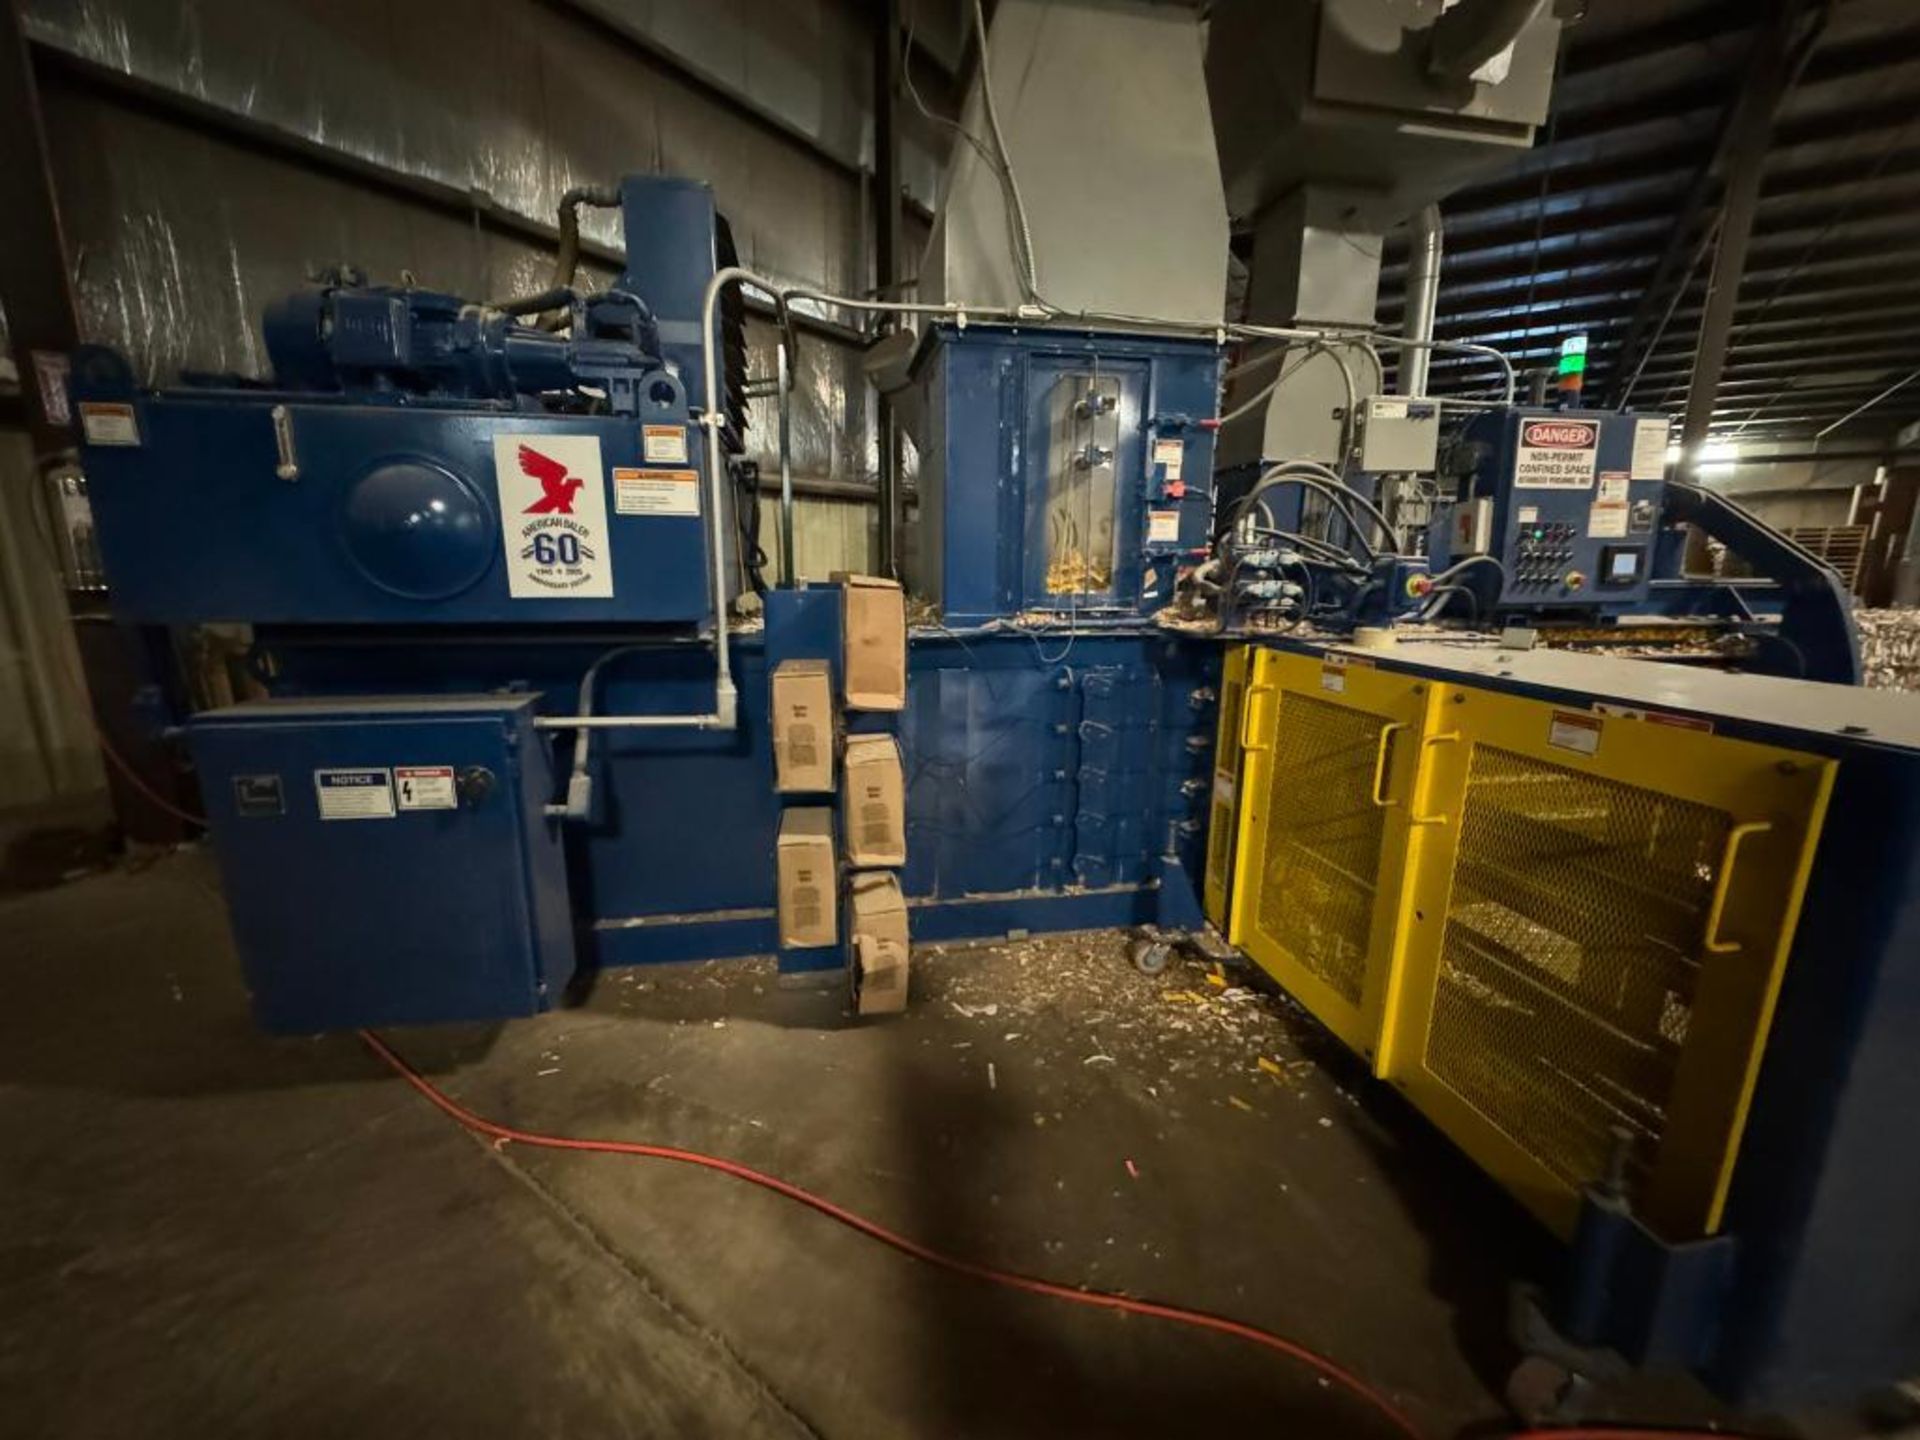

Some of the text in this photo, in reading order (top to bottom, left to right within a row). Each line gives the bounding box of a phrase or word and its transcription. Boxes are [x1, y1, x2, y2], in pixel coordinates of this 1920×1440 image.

[1531, 427, 1587, 443] DANGER
[1530, 452, 1583, 463] NON-PERMIT
[1519, 464, 1591, 475] CONFINED SPACE
[522, 517, 589, 538] AMERICAN BALER
[534, 533, 579, 565] 60
[331, 775, 374, 785] NOTICE
